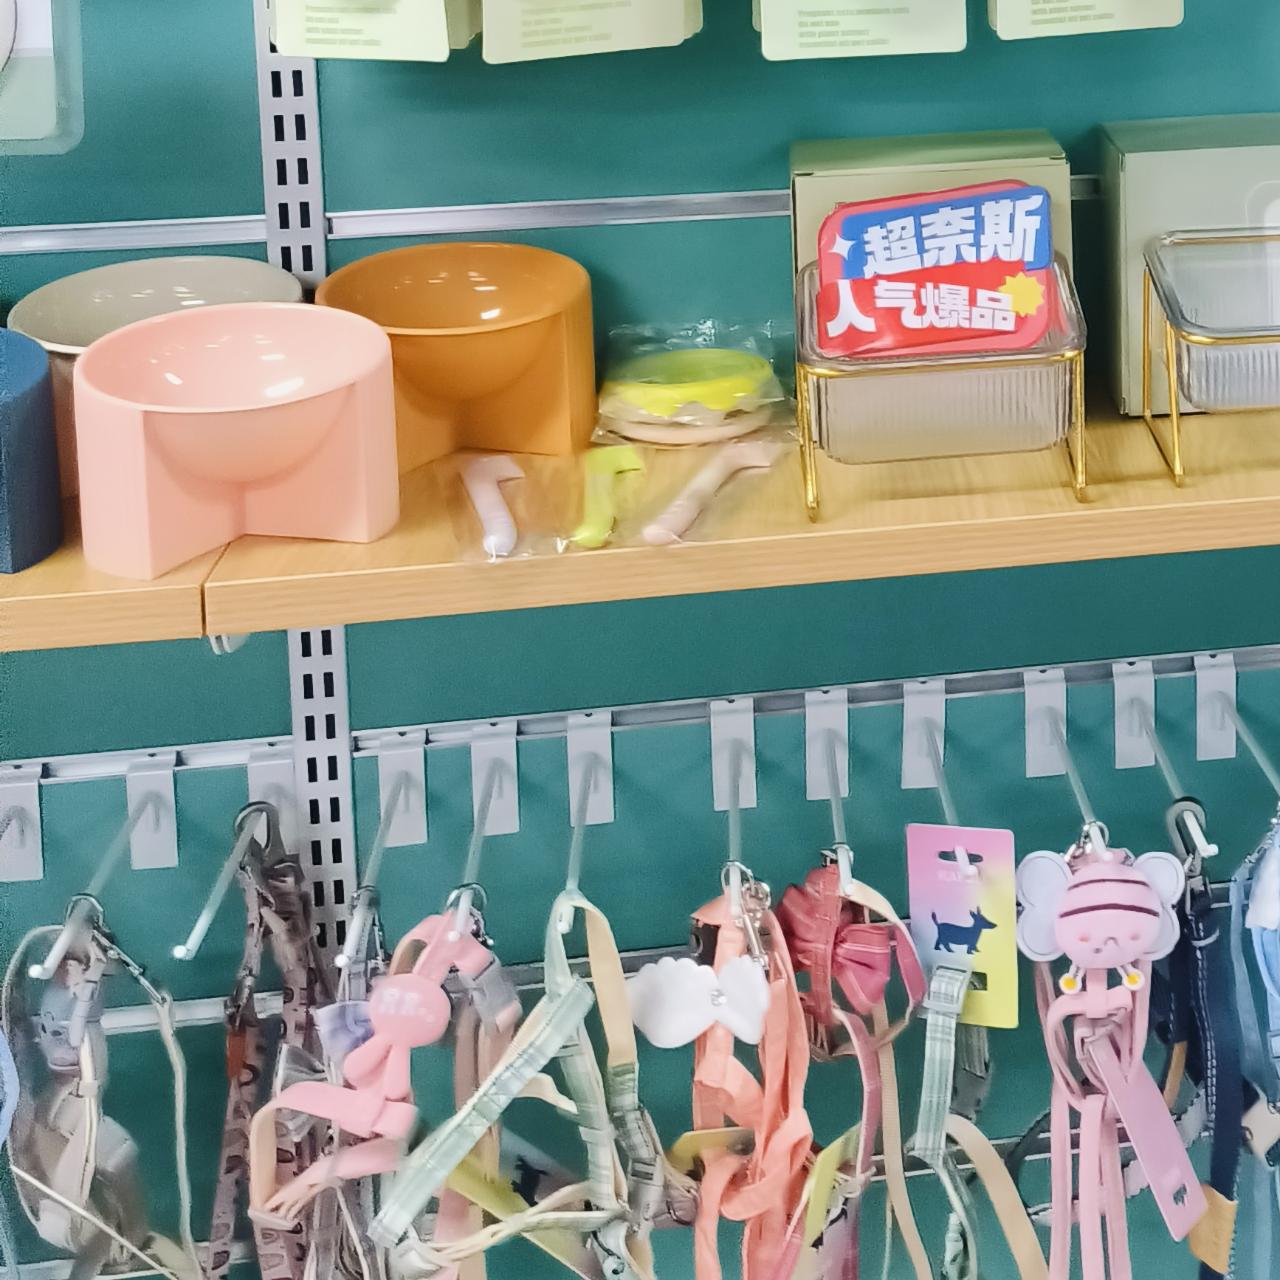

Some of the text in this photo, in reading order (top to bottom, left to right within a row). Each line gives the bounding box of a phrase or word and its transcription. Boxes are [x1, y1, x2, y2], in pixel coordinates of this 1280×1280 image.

[862, 194, 1045, 280] 超奈斯
[826, 279, 1017, 338] 人气爆品
